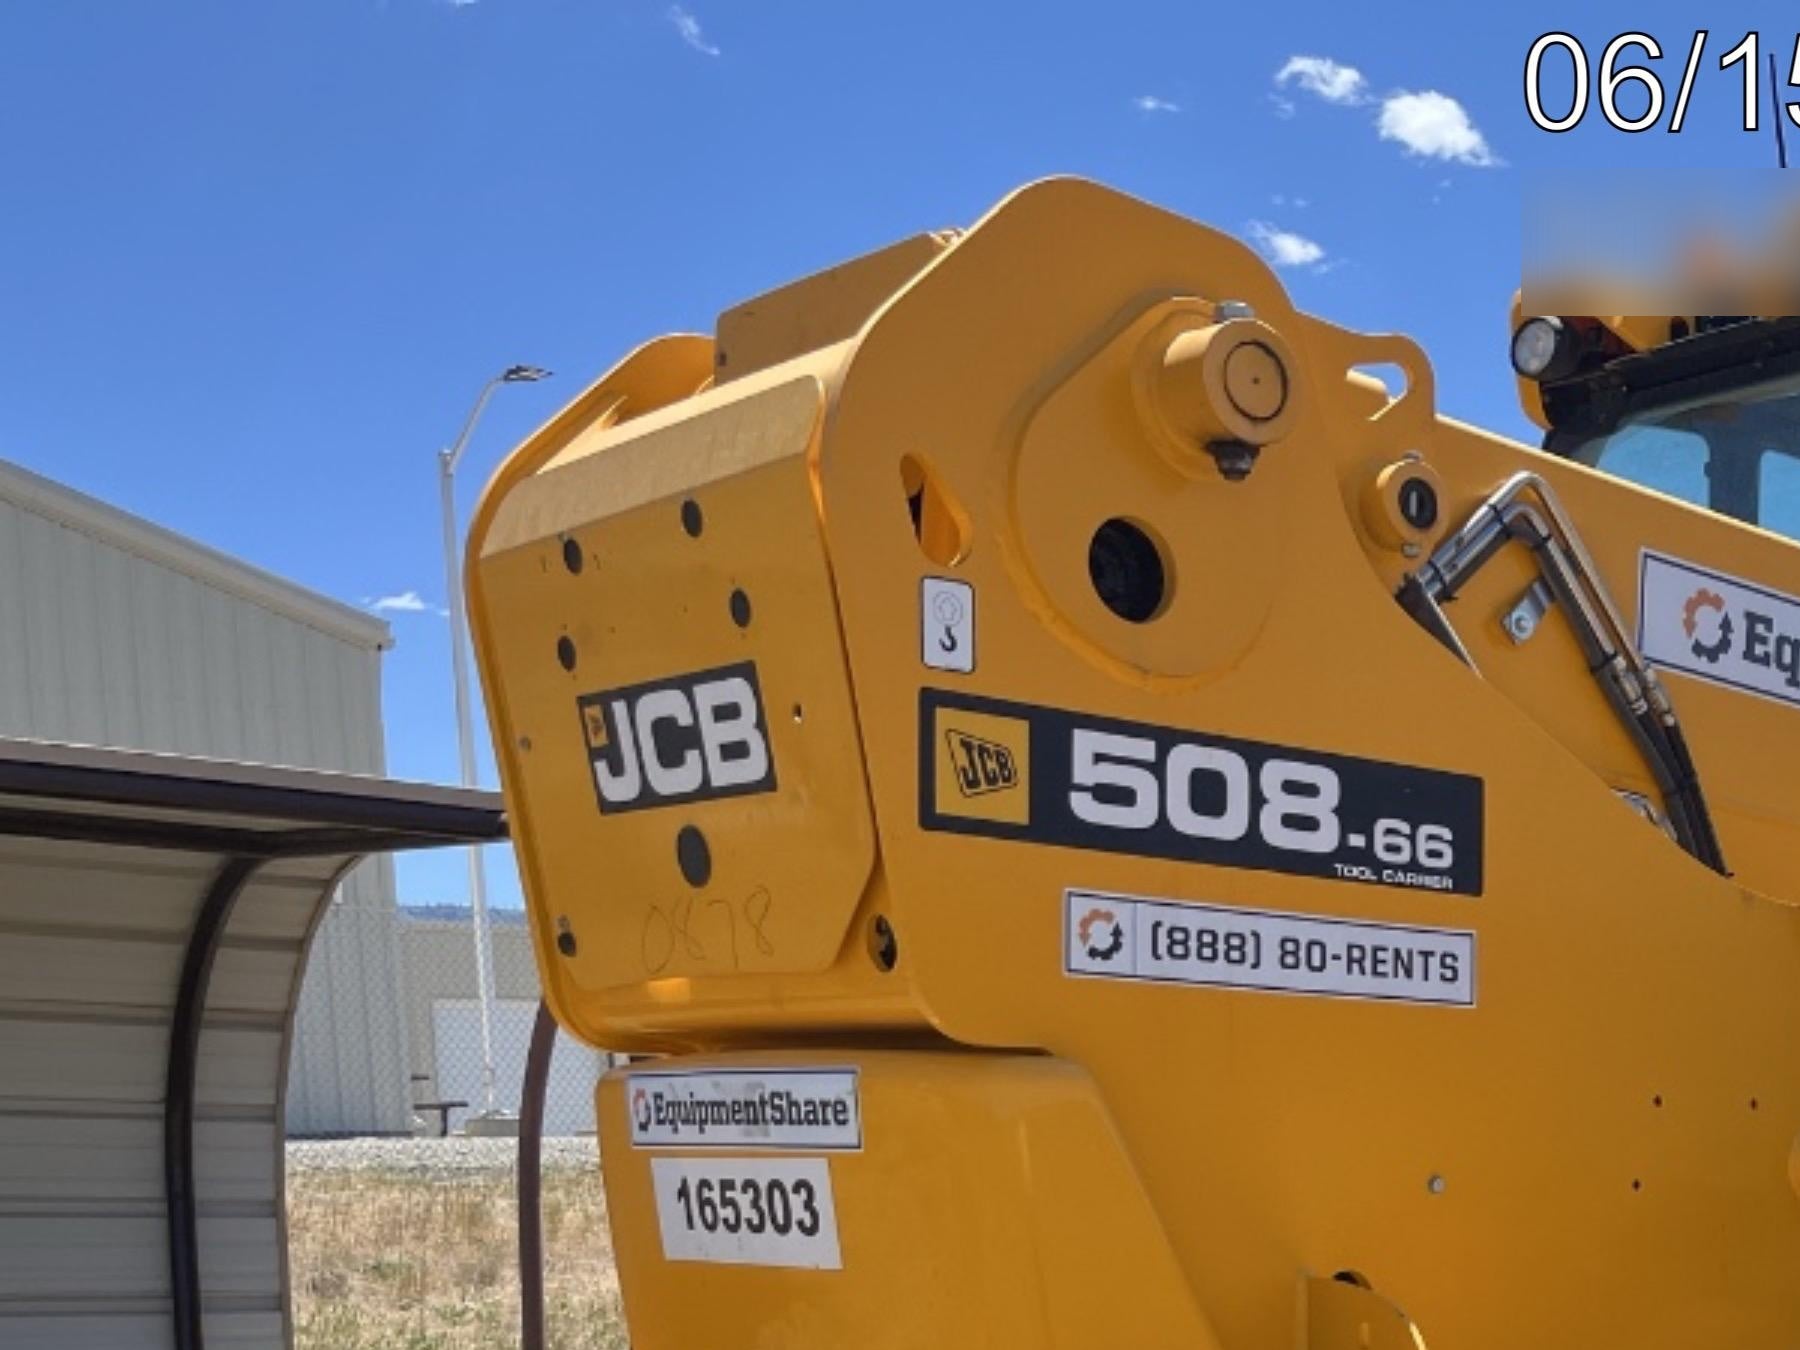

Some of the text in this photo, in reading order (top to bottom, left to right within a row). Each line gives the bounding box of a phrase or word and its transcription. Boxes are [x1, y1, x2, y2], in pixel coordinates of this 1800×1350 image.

[595, 677, 769, 802] JCB
[959, 737, 1013, 789] JCB
[1334, 863, 1453, 890] TOOL CARRIER
[1151, 920, 1460, 984] (888) 80-RENTS
[653, 1091, 849, 1134] EquipmentShare
[677, 1175, 821, 1237] 165303
